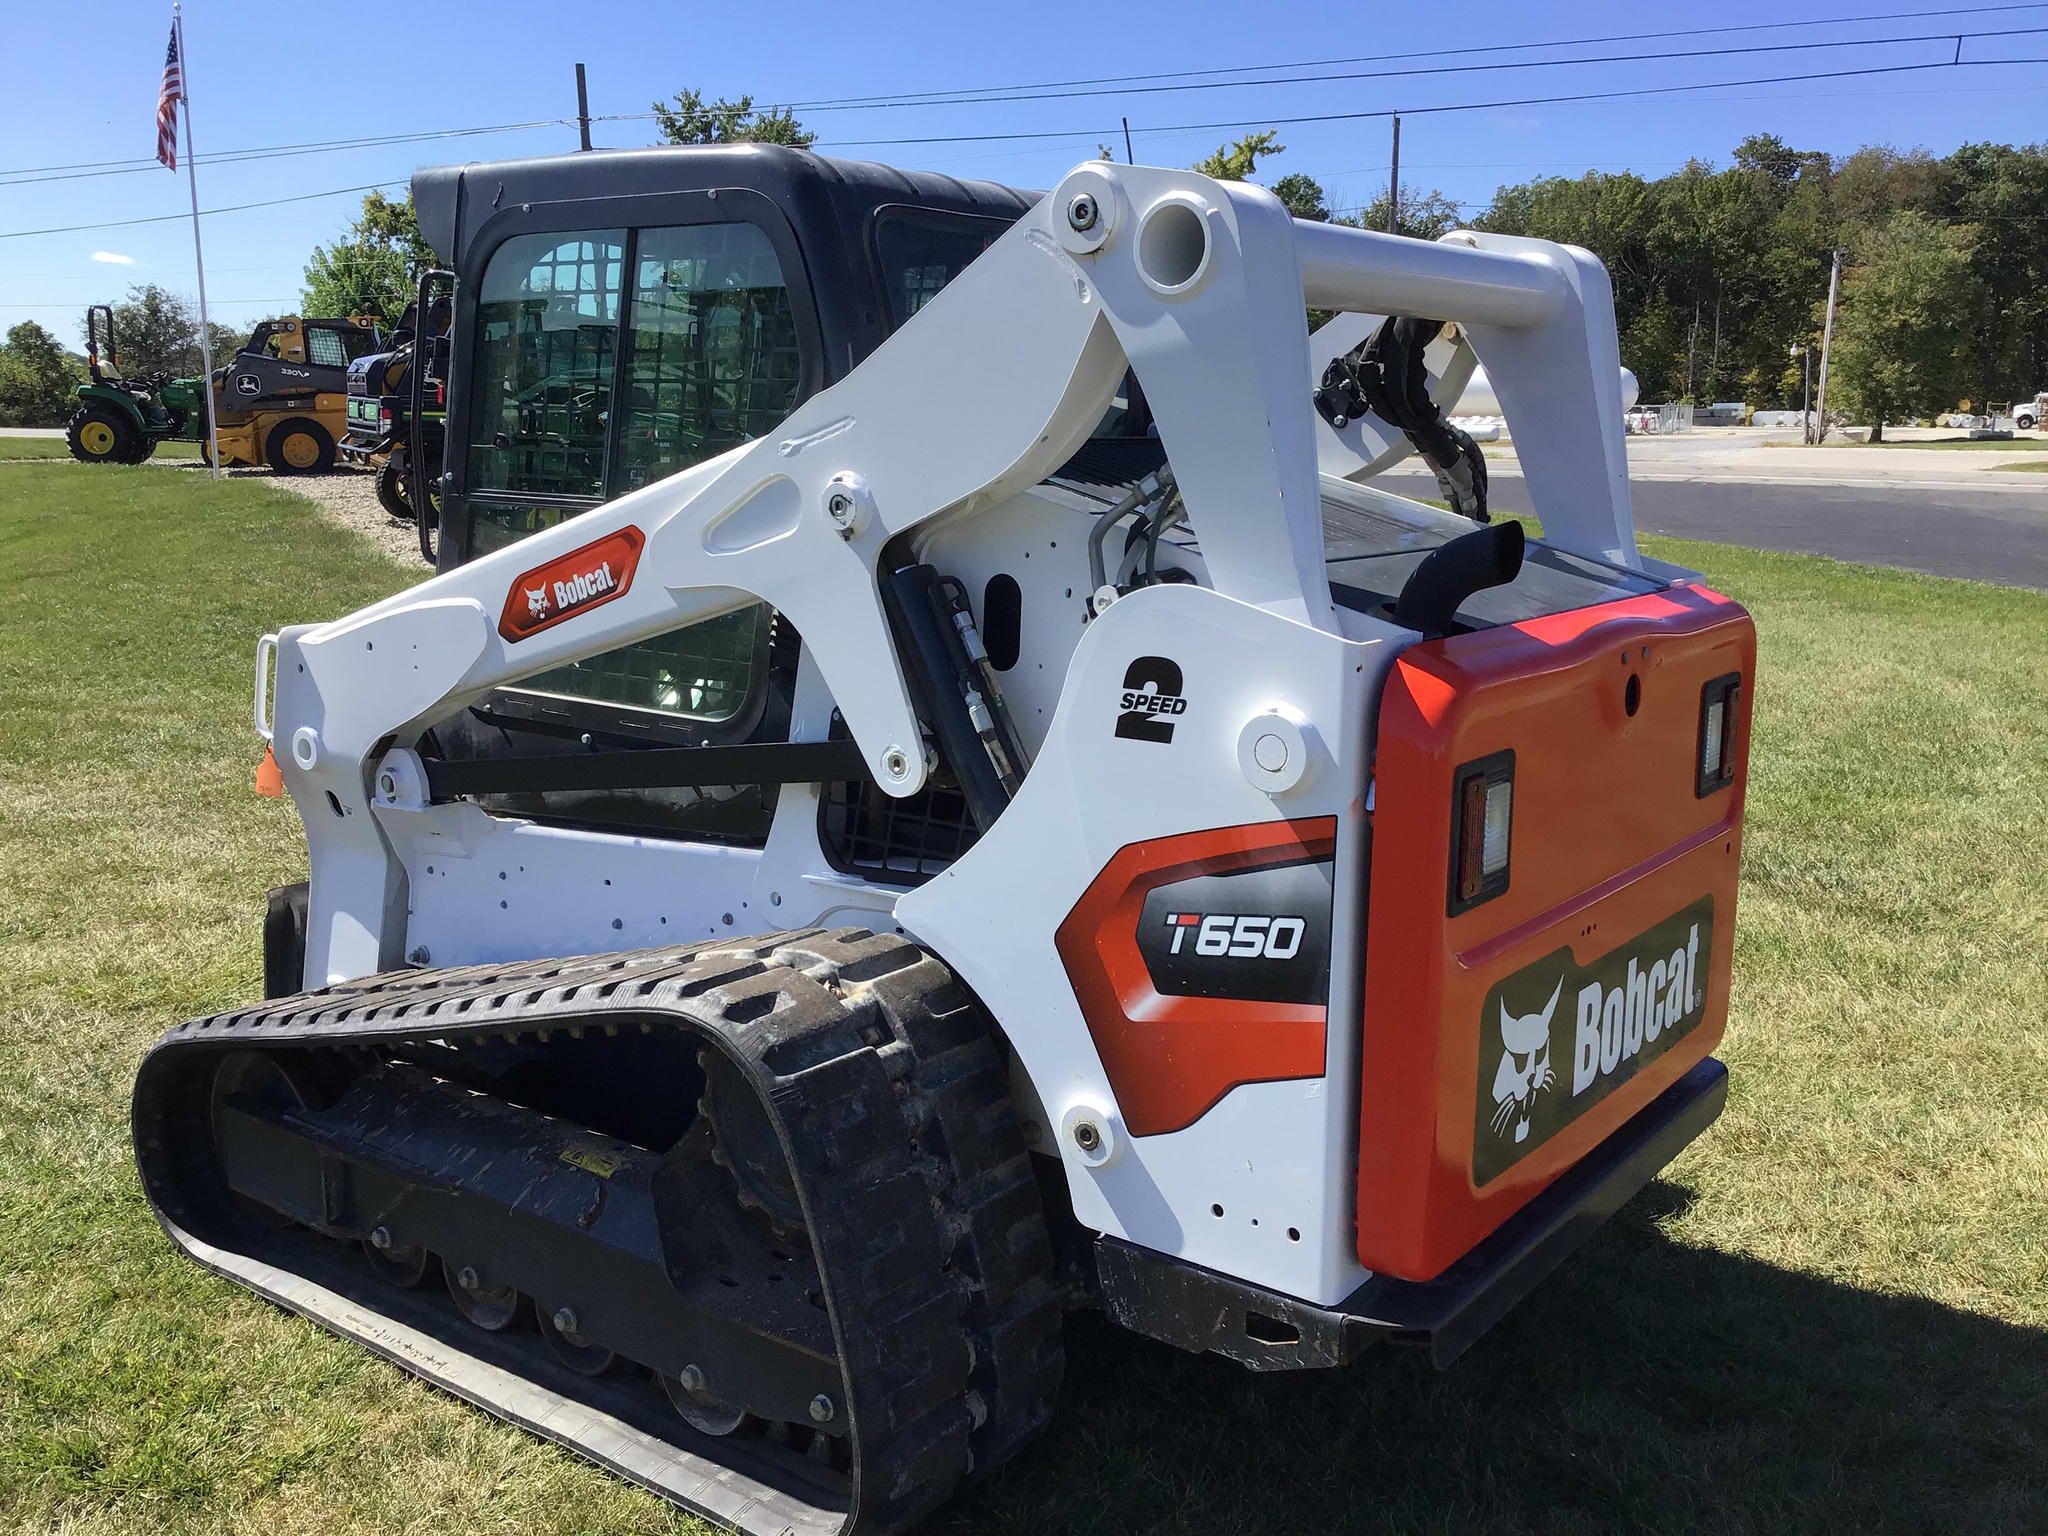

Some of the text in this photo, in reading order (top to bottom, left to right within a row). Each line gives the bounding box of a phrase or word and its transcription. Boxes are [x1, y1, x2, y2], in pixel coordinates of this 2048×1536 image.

[553, 561, 615, 610] Bobcat
[1114, 656, 1183, 744] 2
[1120, 692, 1187, 716] SPEED
[1165, 913, 1307, 960] T650
[1572, 922, 1699, 1098] Bobcat
